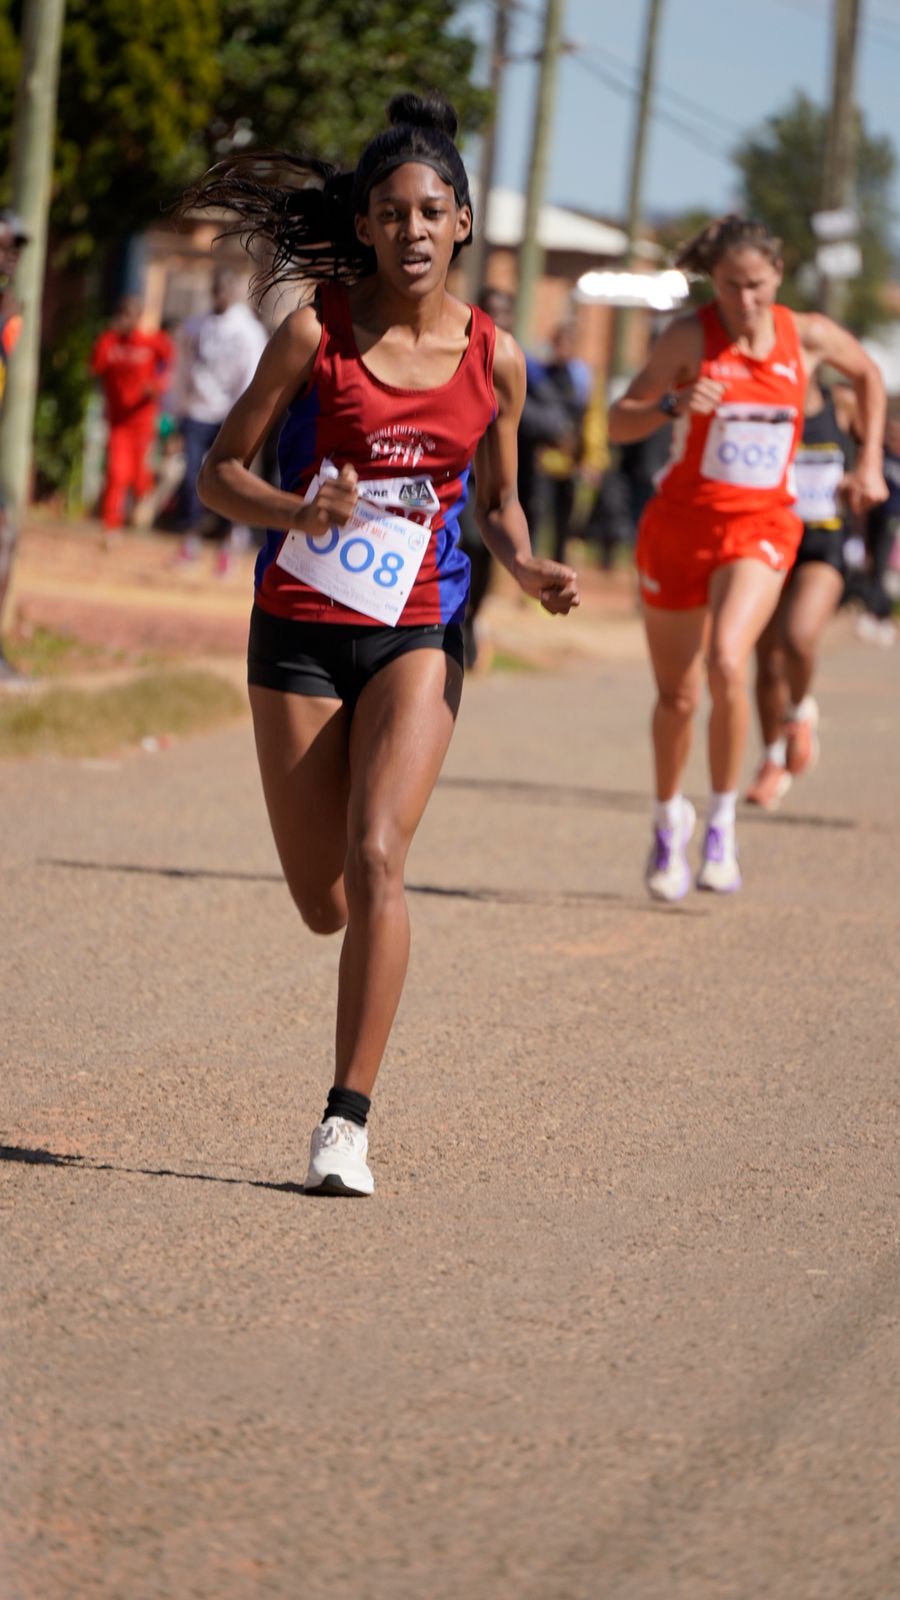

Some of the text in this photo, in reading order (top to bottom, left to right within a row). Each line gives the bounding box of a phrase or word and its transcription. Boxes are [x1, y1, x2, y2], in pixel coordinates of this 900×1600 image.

[718, 441, 777, 468] 005
[401, 482, 430, 500] ASA
[306, 526, 405, 588] 008
